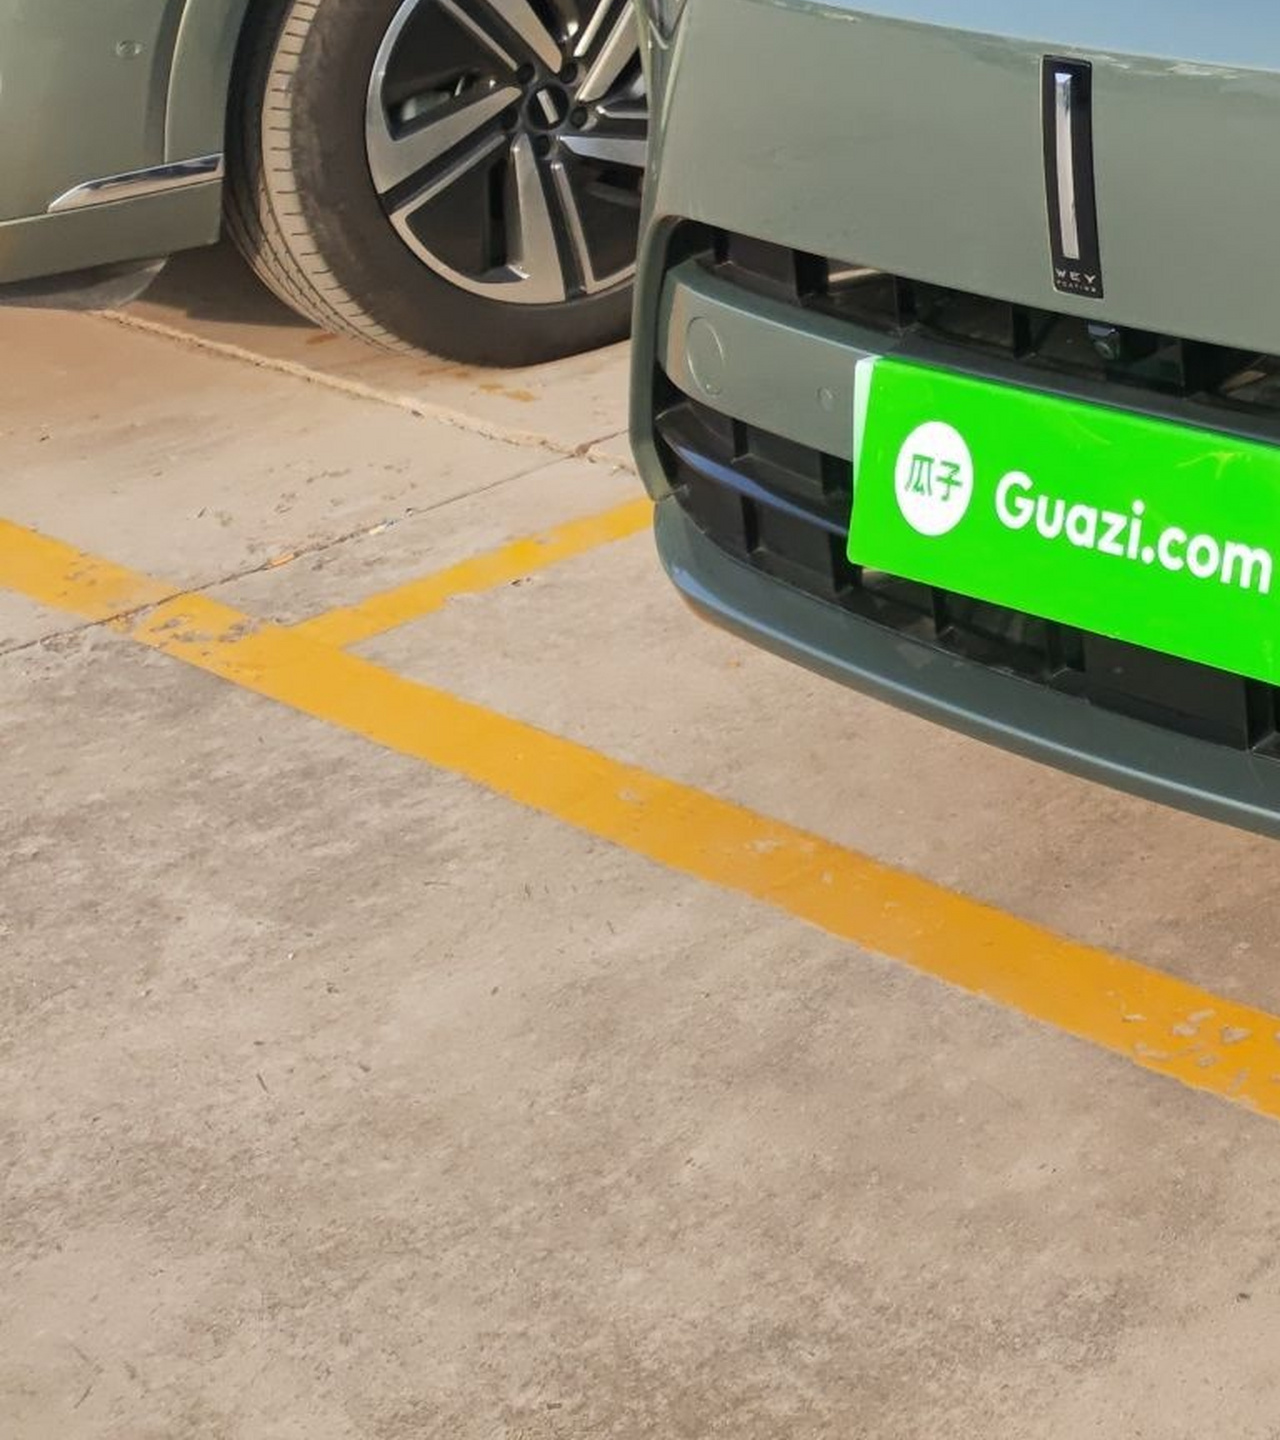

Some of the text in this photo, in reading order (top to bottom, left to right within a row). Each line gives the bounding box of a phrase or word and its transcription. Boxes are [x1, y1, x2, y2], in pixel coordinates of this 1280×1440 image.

[1055, 267, 1096, 284] WEY
[904, 453, 963, 502] 瓜子
[995, 470, 1273, 595] Guazi.com
